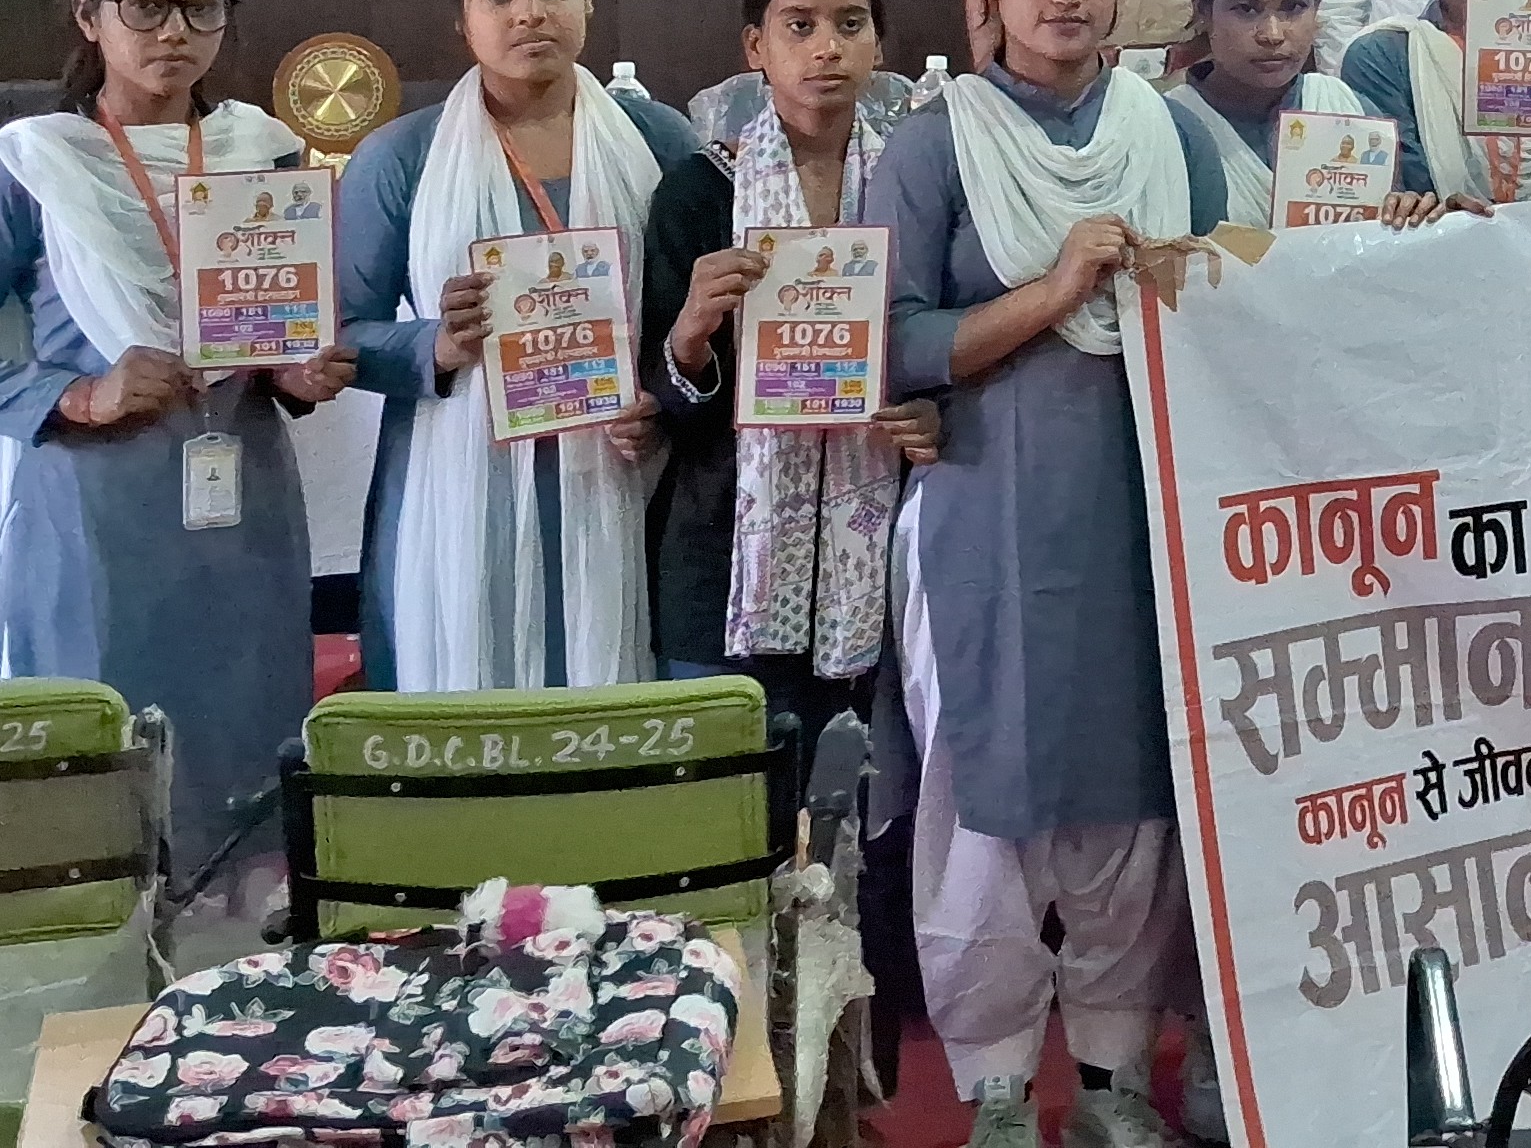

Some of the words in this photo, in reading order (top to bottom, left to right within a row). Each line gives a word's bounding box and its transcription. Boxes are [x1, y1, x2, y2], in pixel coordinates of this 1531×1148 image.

[1303, 204, 1365, 225] 1076
[218, 267, 299, 291] 1076
[518, 323, 595, 354] 1076
[776, 323, 851, 345] 1076
[1218, 469, 1441, 598] कानून
[1449, 500, 1528, 580] का
[551, 717, 697, 763] 24-25
[1295, 772, 1408, 850] कानून
[1413, 750, 1447, 822] से
